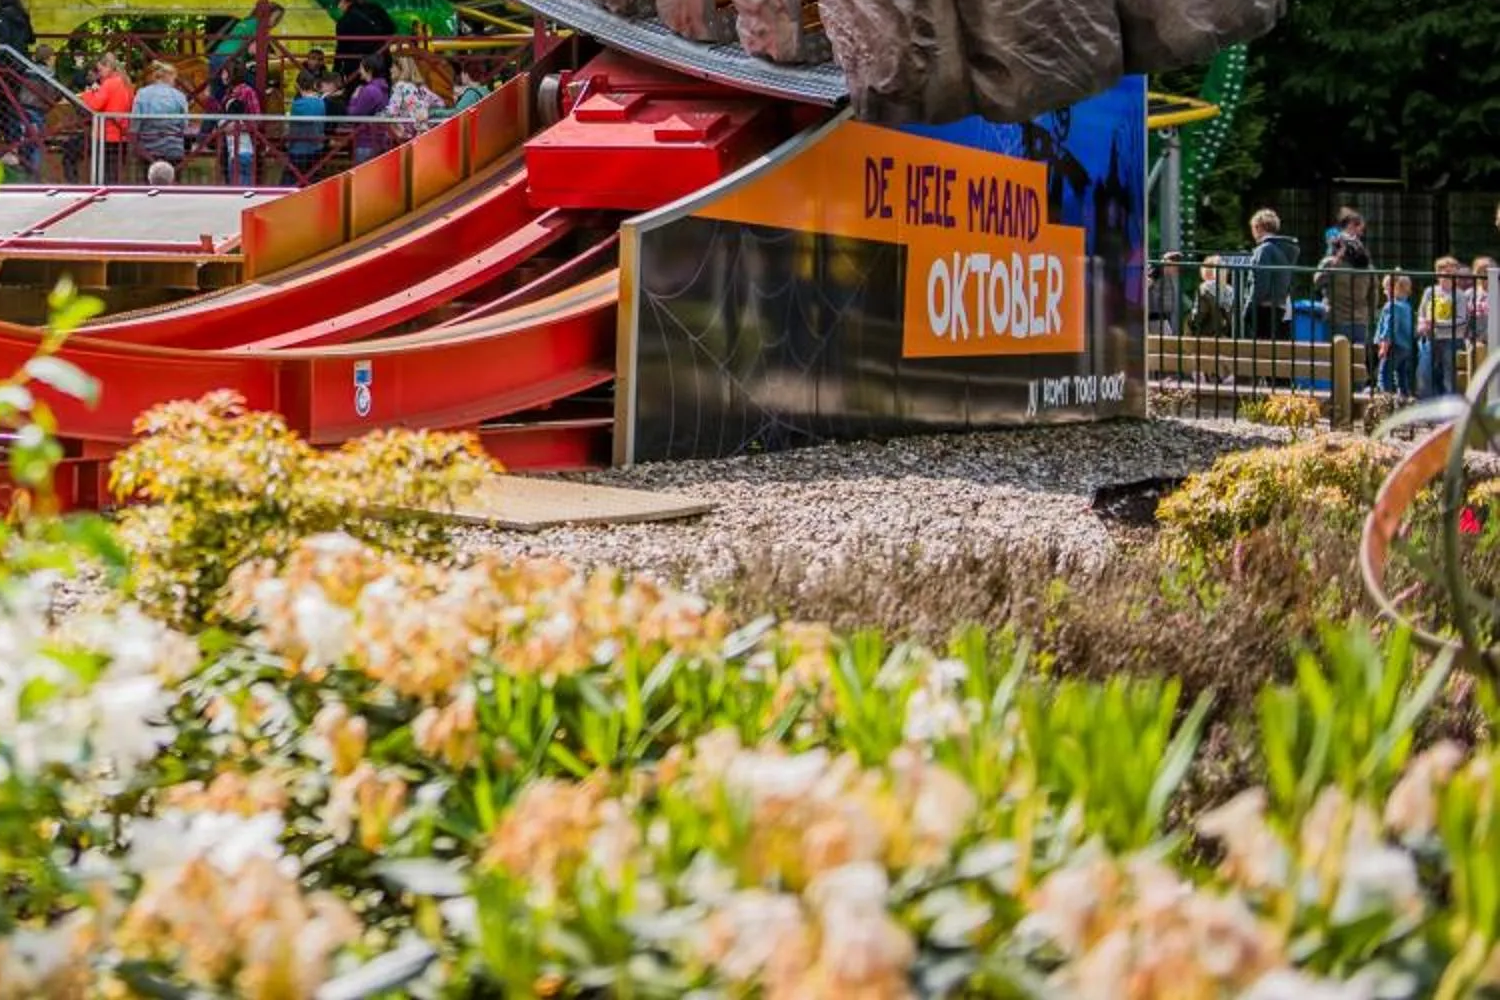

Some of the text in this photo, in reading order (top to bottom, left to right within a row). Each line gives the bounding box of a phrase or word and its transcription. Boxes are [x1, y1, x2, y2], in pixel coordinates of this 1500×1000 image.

[865, 157, 1041, 243] DE HELE MAAND
[927, 251, 1063, 341] OKTOBER
